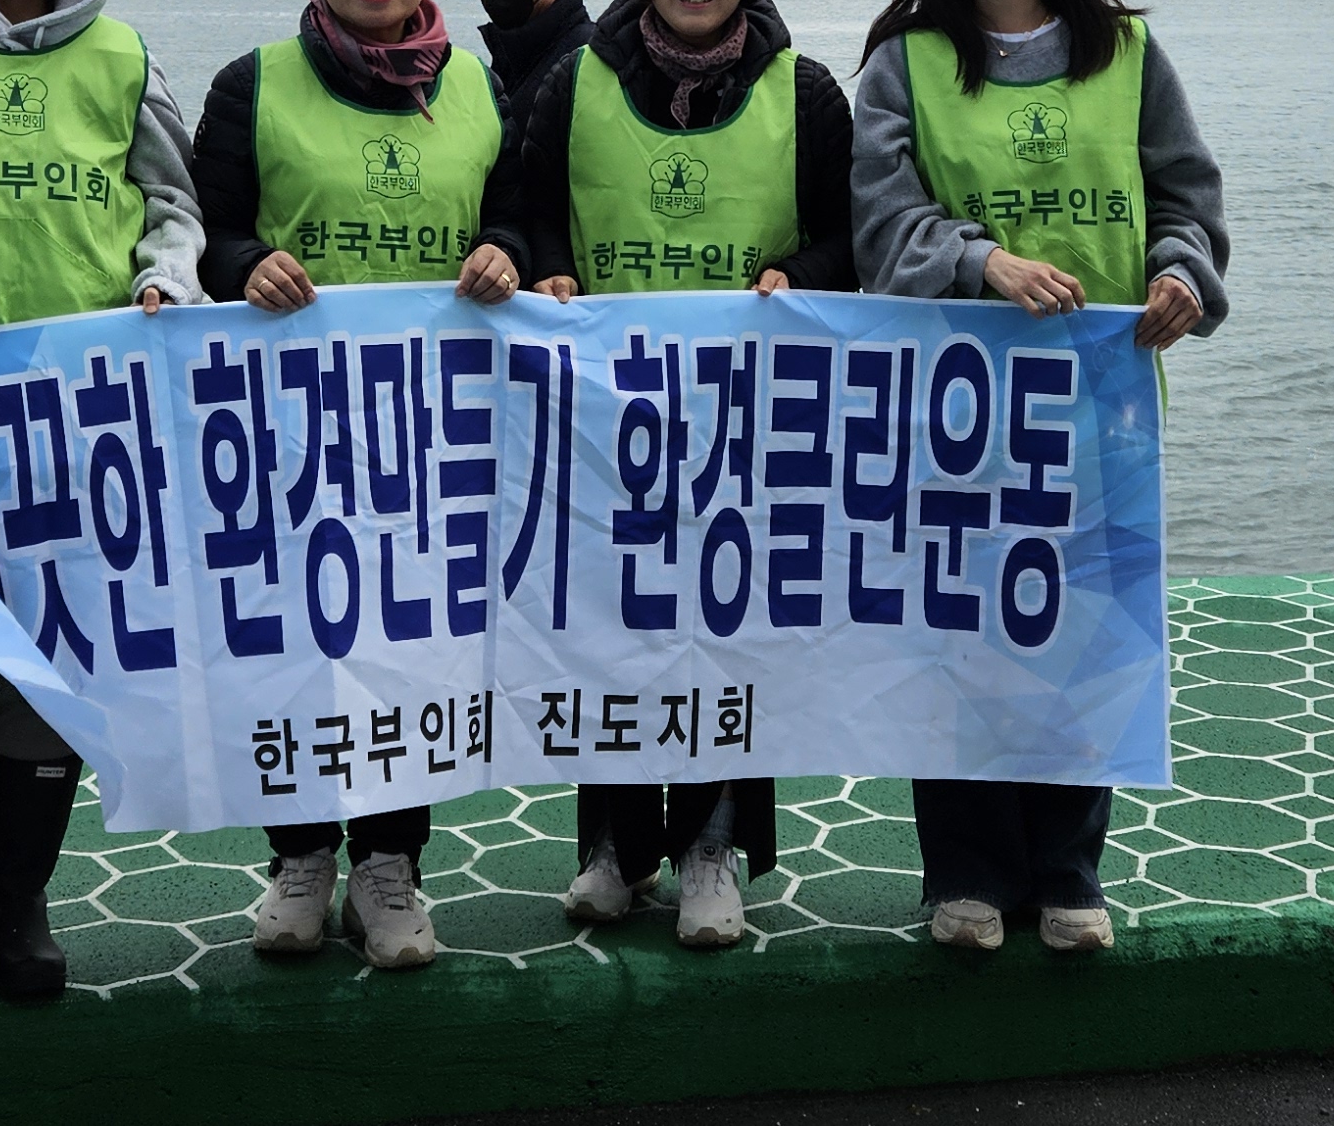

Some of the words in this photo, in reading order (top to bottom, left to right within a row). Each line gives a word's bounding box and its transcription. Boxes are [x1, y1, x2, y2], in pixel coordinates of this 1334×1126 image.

[1017, 142, 1065, 155] 한국부인회
[370, 176, 417, 191] 한국부인회
[655, 196, 702, 210] 한국부인회
[963, 188, 1134, 229] 한국부인회
[591, 240, 762, 281] 한국부인회
[192, 337, 573, 659] 환경만들기
[612, 334, 1078, 647] 환경클린운동
[252, 691, 493, 795] 한국부인회
[537, 684, 753, 757] 진도지회
